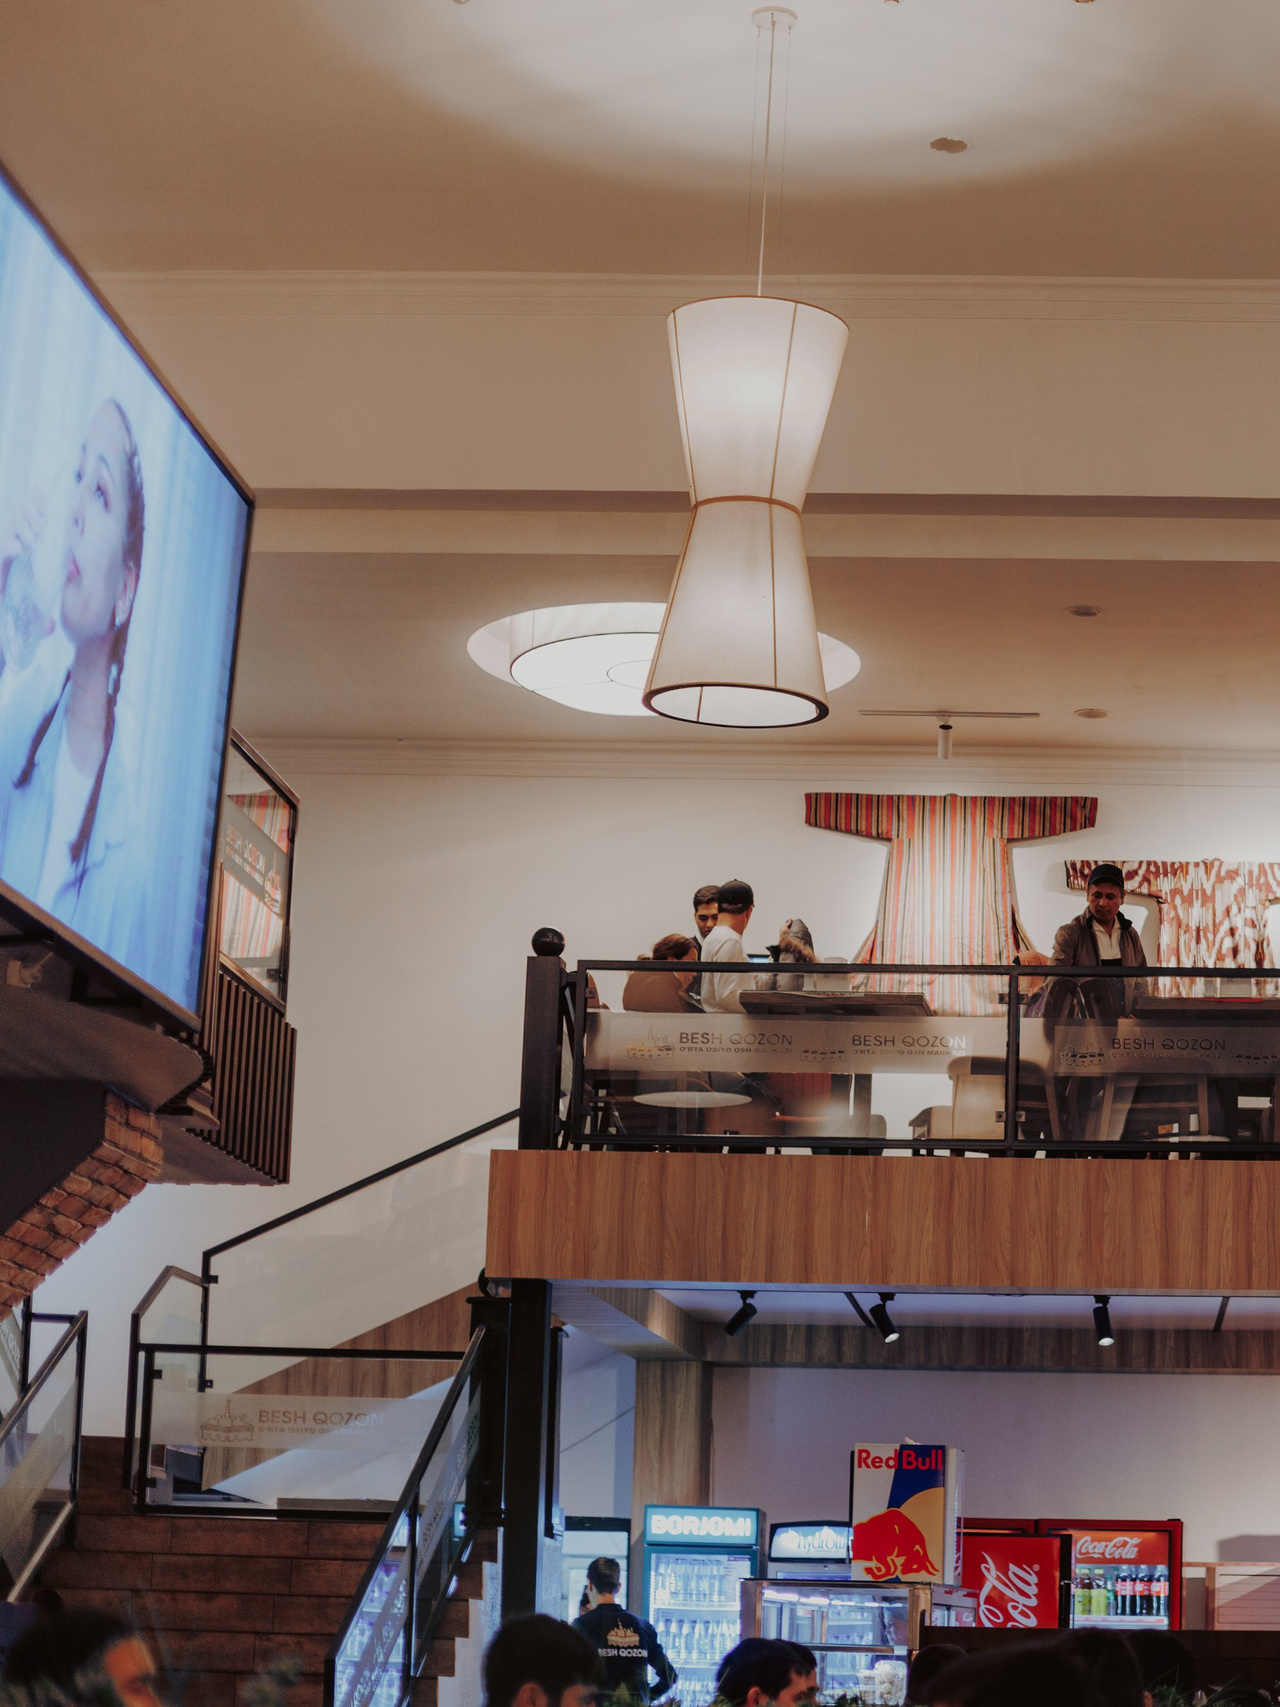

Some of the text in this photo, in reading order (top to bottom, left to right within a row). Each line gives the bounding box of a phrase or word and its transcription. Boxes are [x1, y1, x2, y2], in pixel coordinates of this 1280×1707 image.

[679, 1032, 793, 1046] BESH QOZON
[851, 1034, 967, 1049] BESH QOZON
[1112, 1037, 1226, 1051] BESH QOZON
[258, 1410, 384, 1427] BESH QOZON
[857, 1449, 943, 1470] Red Bull
[650, 1514, 752, 1537] BORJOMI
[1076, 1536, 1143, 1559] Coca-Cola
[597, 1648, 648, 1658] BESH QOZON
